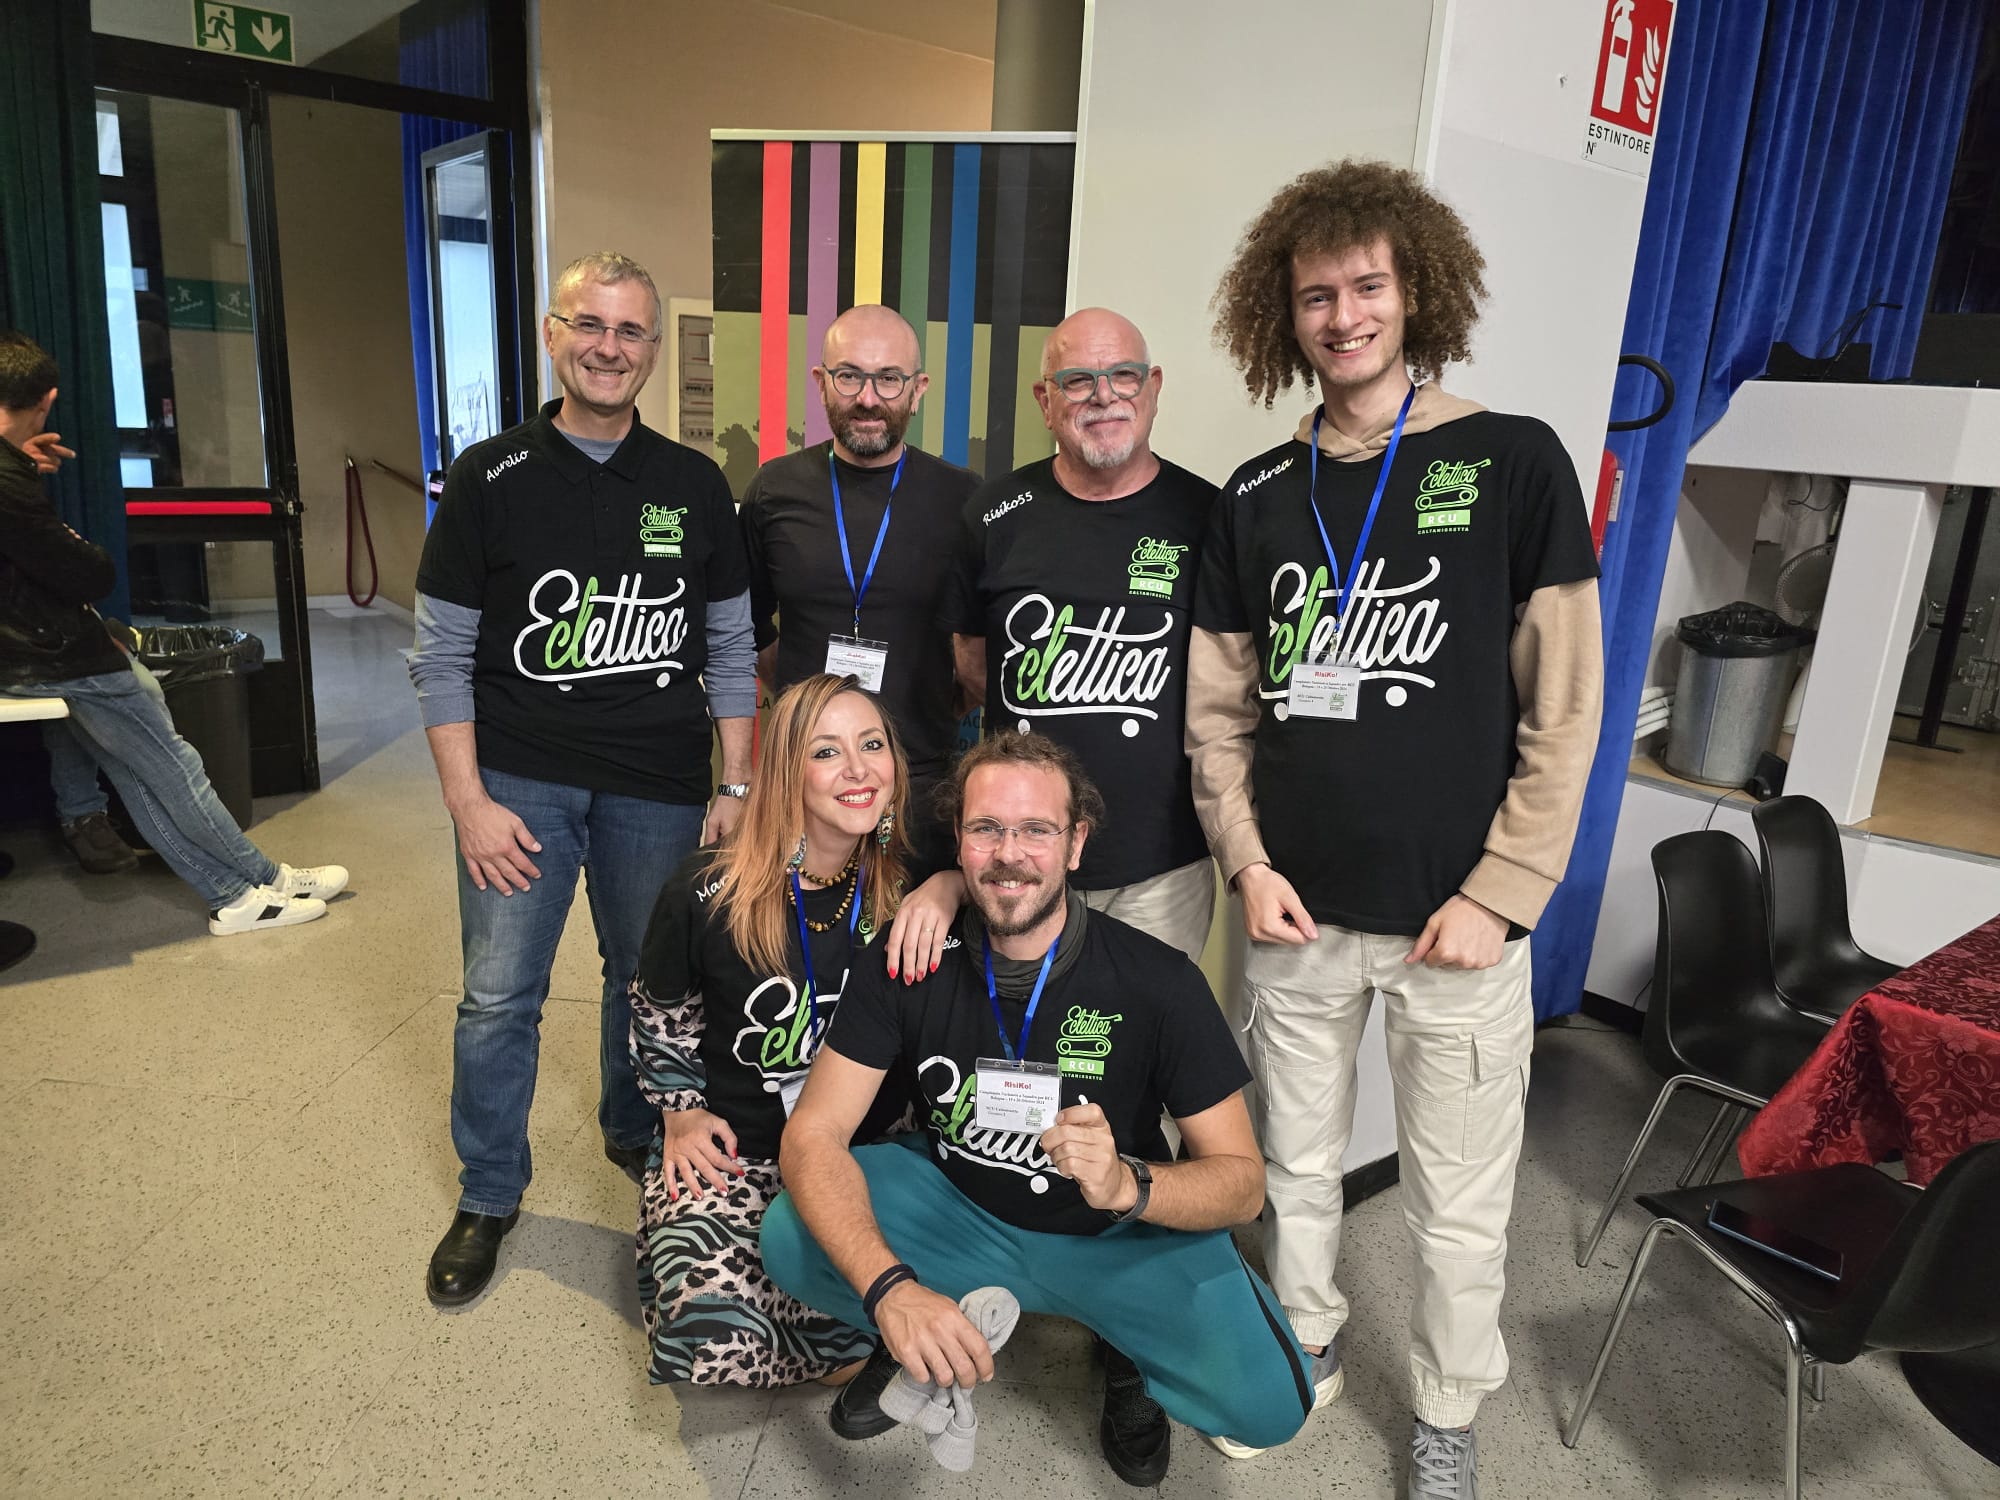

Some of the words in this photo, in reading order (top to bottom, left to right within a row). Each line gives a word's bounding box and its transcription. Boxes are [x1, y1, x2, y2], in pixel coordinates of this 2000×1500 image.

[1588, 122, 1651, 155] ESTINTORE
[486, 450, 529, 482] Aurelio
[1236, 457, 1294, 496] Andrea
[1419, 458, 1492, 493] Eclettica
[639, 503, 688, 529] Eclettica
[982, 490, 1033, 527] Risiko55
[1427, 513, 1457, 525] RCU
[1131, 536, 1189, 562] Eclettica
[513, 568, 689, 682] Eclettica
[1000, 593, 1174, 720] Eclettica
[1060, 1005, 1123, 1038] Eclettica
[1069, 1060, 1095, 1071] RCU
